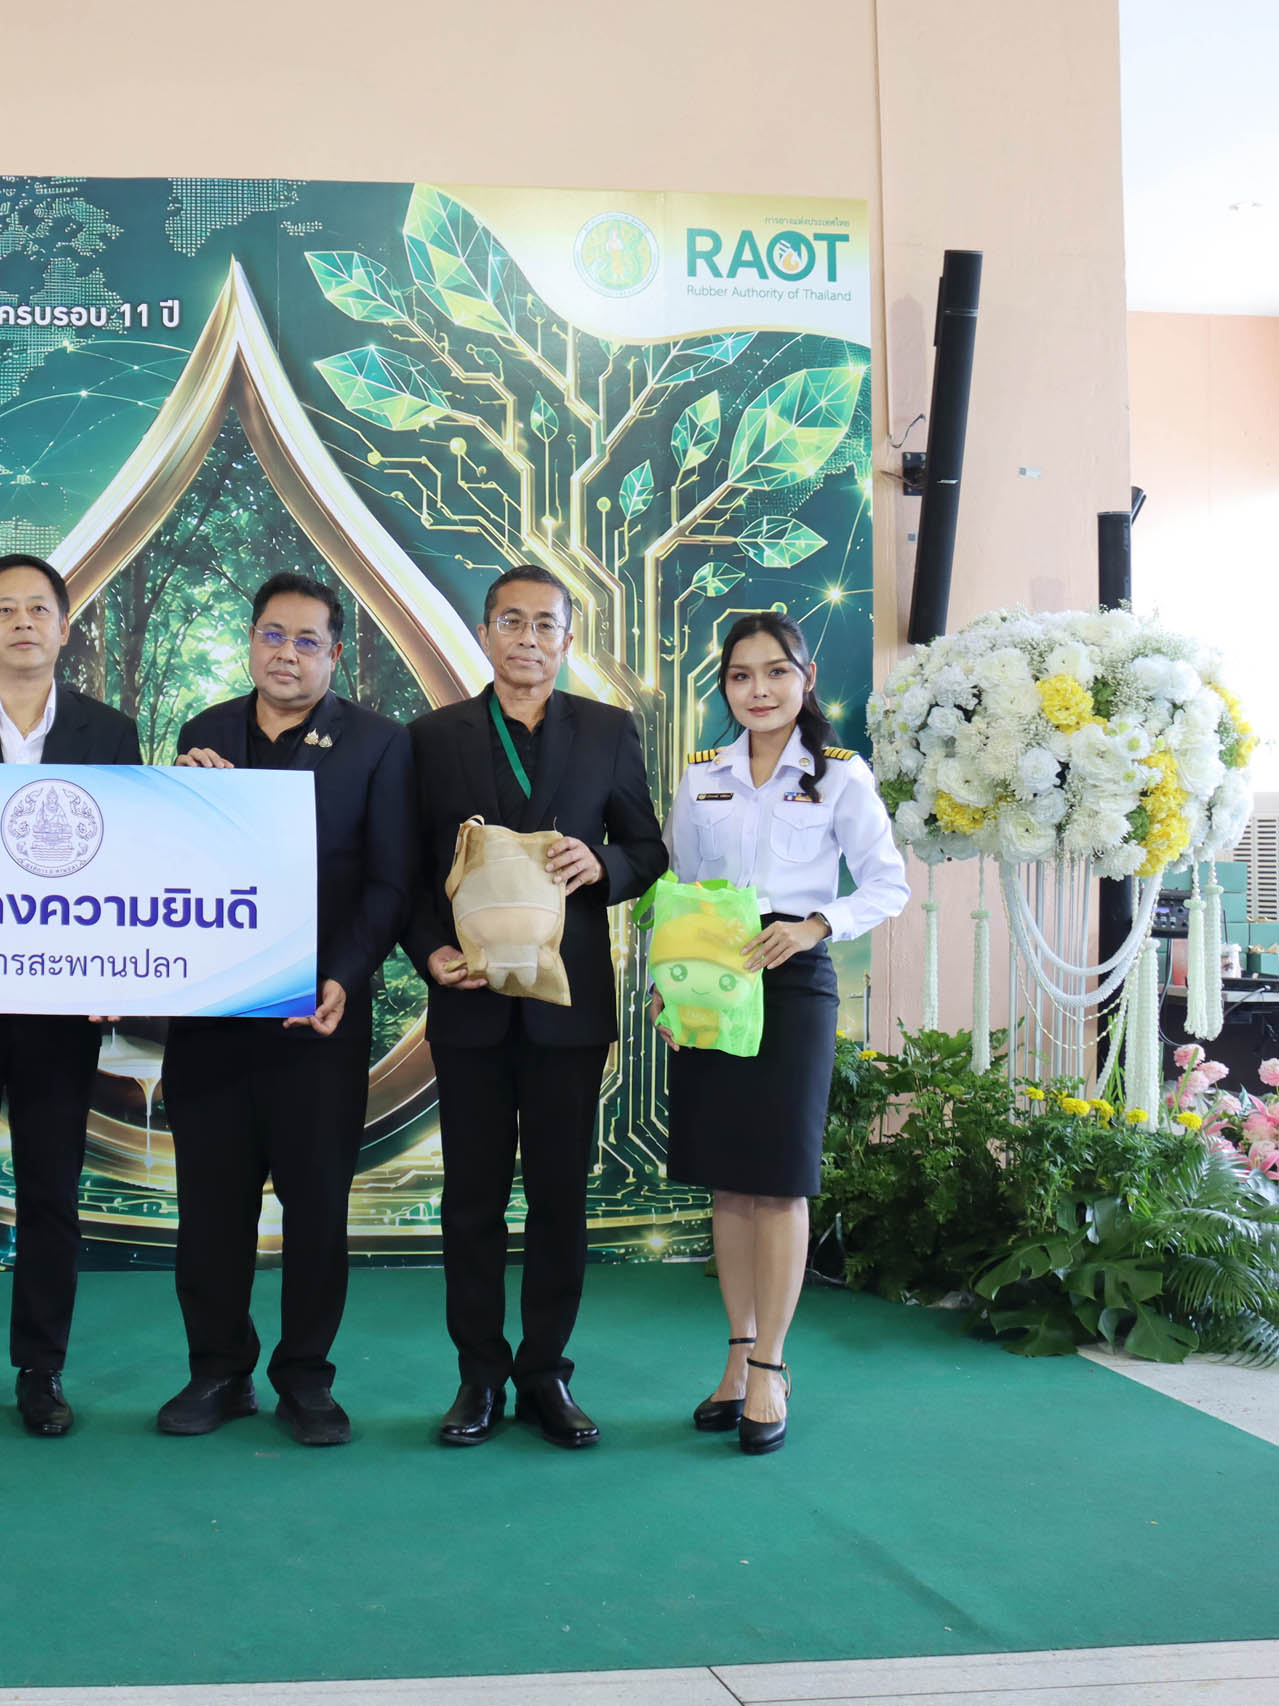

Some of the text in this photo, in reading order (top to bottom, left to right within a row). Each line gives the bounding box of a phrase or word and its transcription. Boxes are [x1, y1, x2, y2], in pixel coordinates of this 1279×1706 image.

[686, 228, 850, 283] RAOT
[687, 284, 852, 302] Rubber Authority of Thailand
[119, 302, 149, 328] 11
[160, 298, 180, 328] ปี
